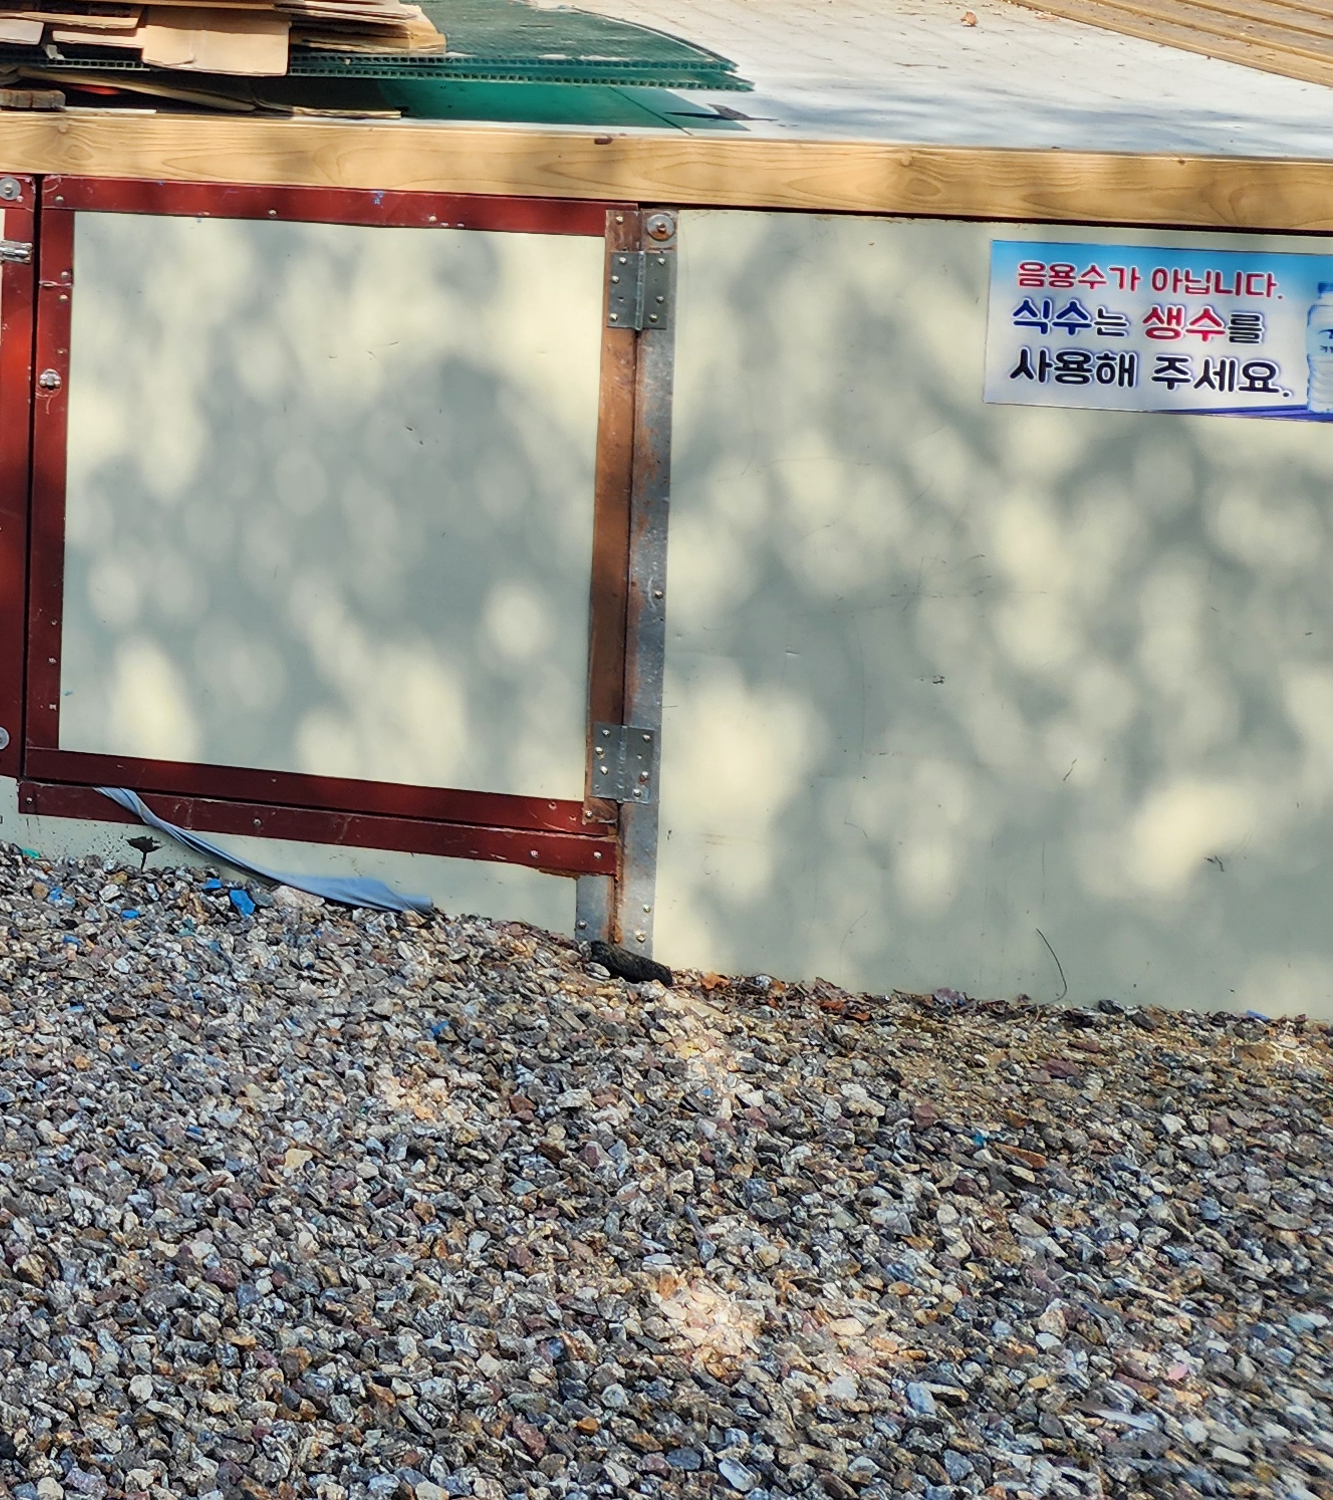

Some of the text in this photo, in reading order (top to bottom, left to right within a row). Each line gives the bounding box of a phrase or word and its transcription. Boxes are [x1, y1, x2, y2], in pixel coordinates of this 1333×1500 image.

[1016, 260, 1284, 299] 음용수가 아닙니다.
[1012, 298, 1265, 344] 식수는 생수를
[1009, 348, 1292, 397] 사용해 주세요.
